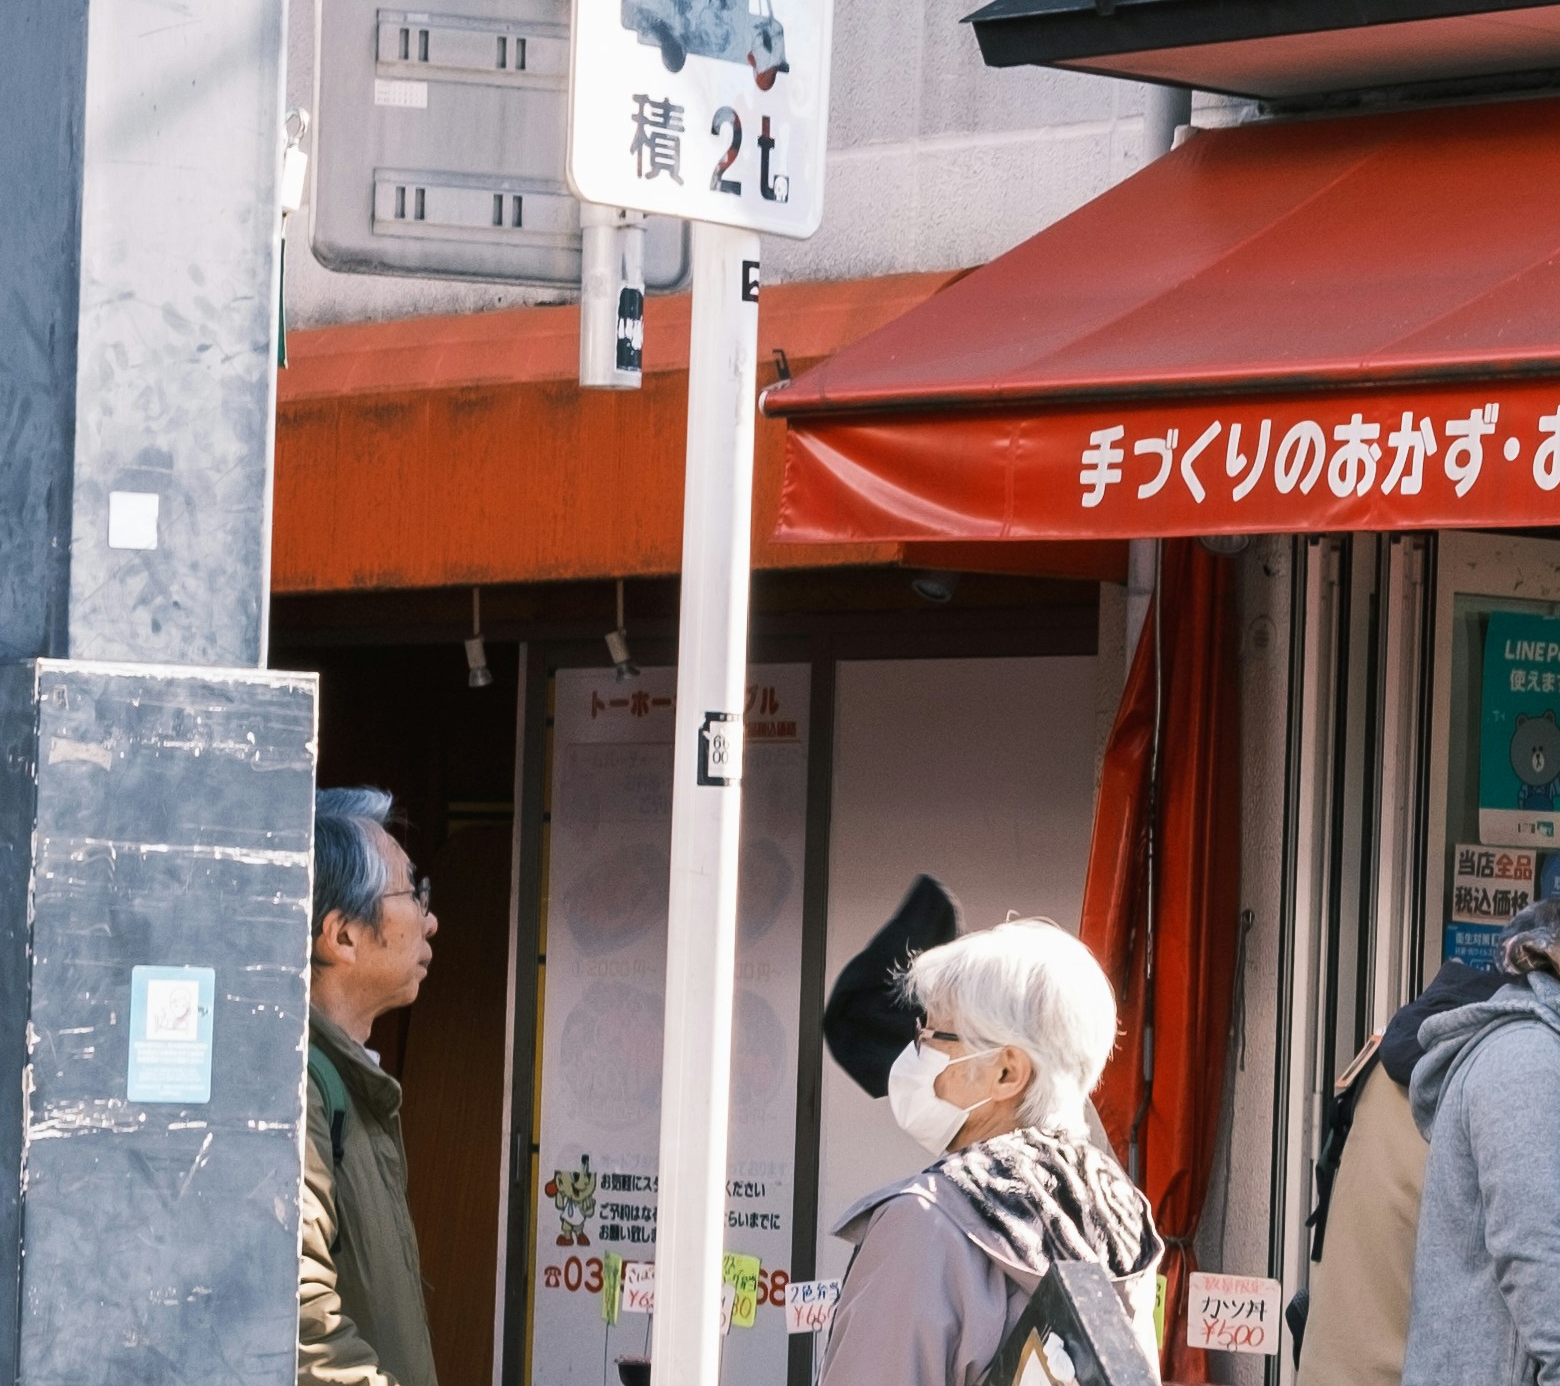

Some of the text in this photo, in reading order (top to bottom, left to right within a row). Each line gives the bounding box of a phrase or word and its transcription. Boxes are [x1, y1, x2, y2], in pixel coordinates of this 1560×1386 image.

[1504, 639, 1545, 663] LINE
[1458, 849, 1533, 881] 当店全品
[1455, 885, 1530, 917] 税込価格
[725, 1213, 781, 1231] らいまでに
[1201, 1318, 1265, 1347] ¥500
